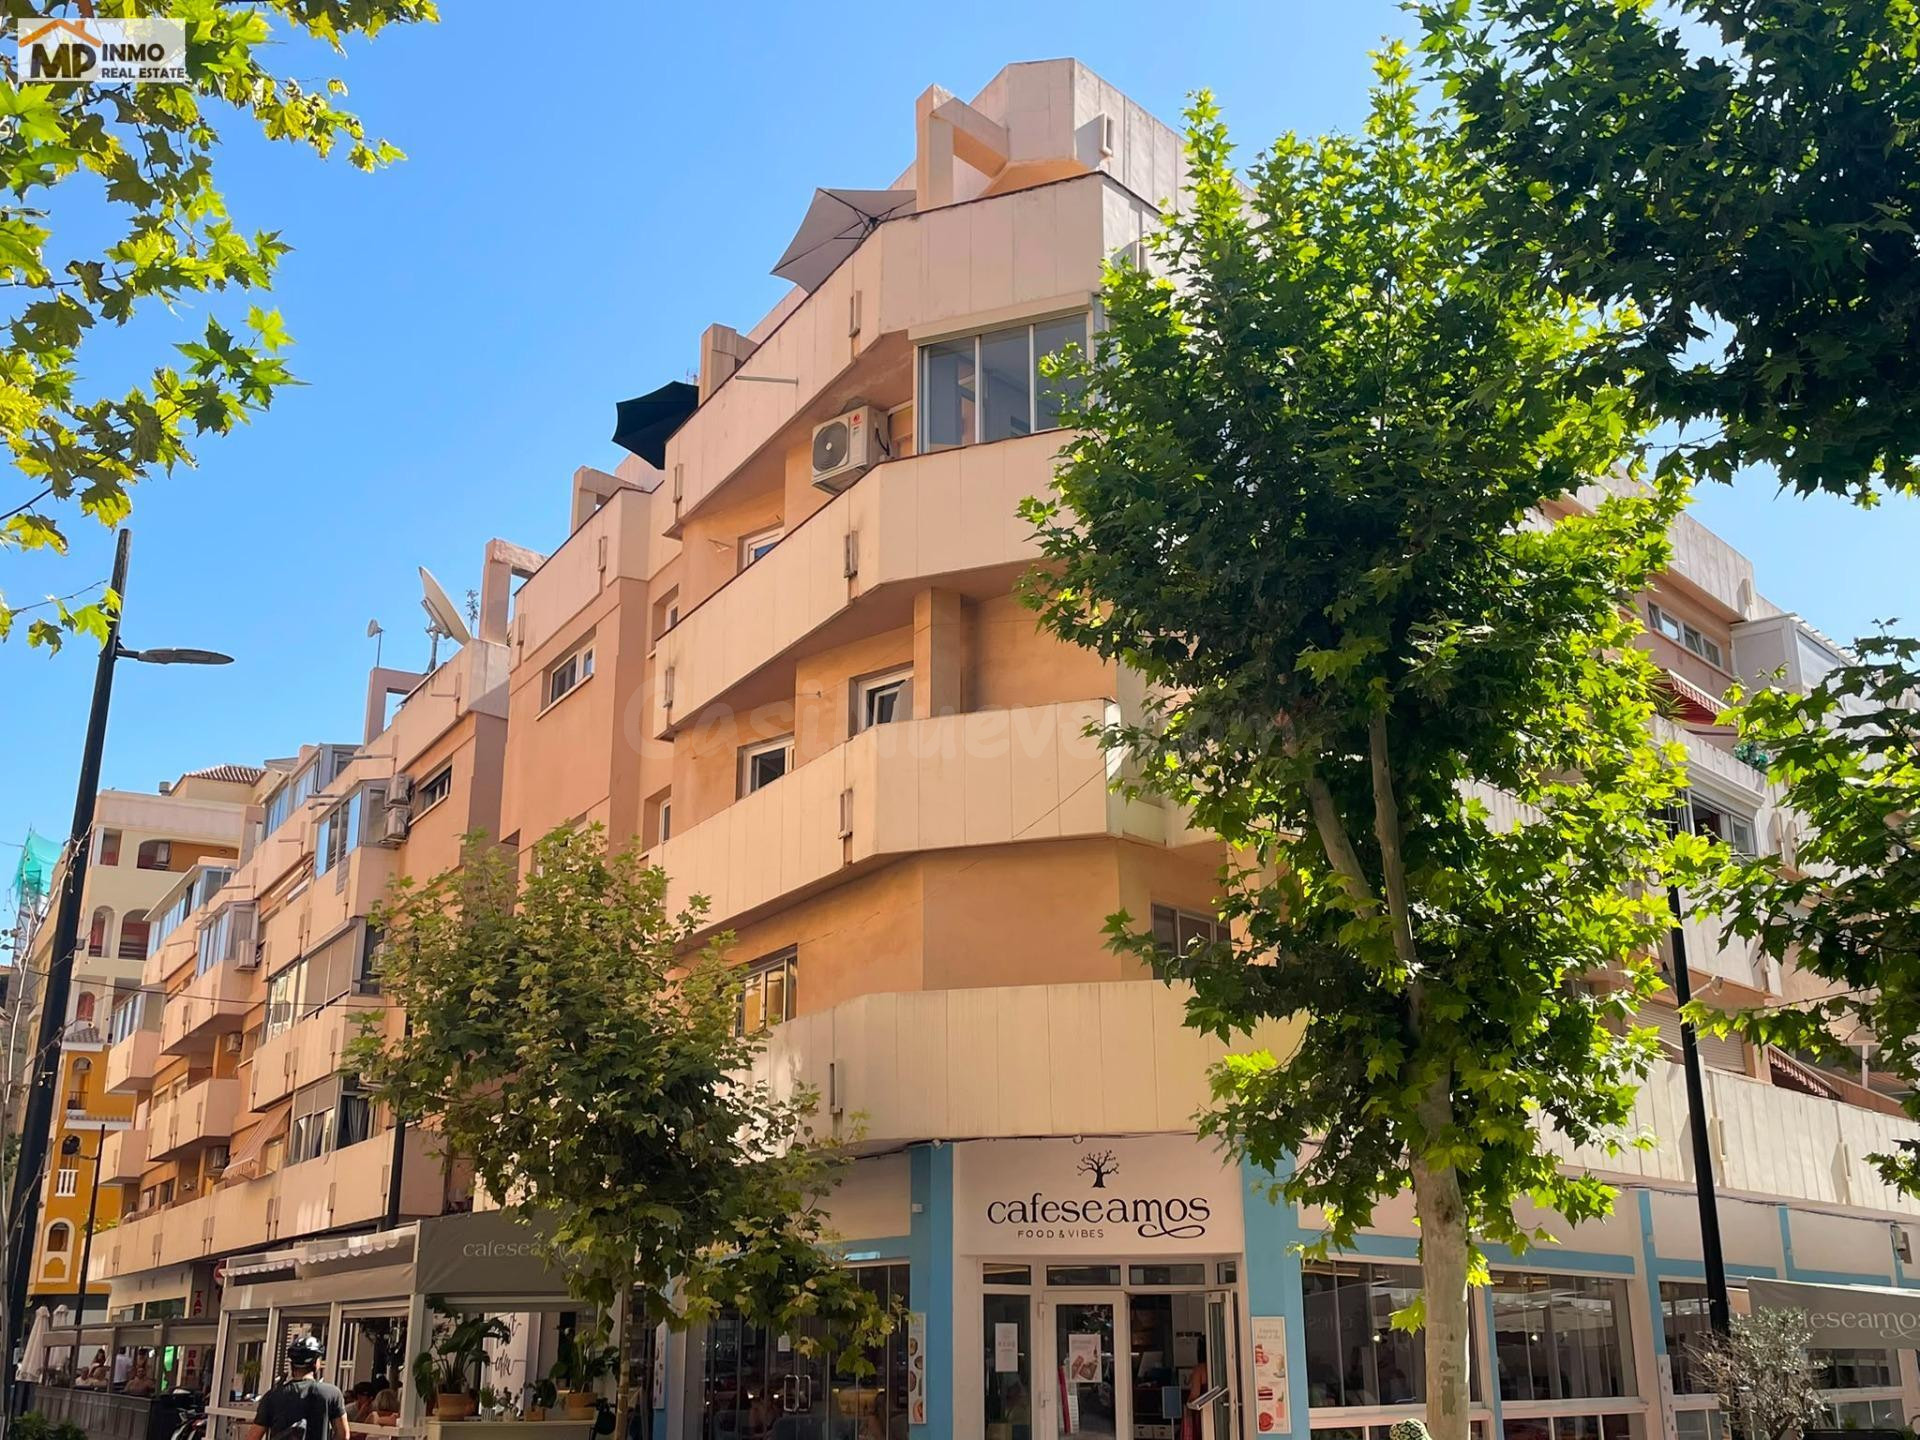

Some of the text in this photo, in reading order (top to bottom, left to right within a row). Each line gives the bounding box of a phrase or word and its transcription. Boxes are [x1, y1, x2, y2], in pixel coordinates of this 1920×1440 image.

[986, 1192, 1211, 1240] cafeseamos
[1017, 1228, 1105, 1239] FOOD & VIBES
[1802, 1308, 1920, 1340] feseamo
